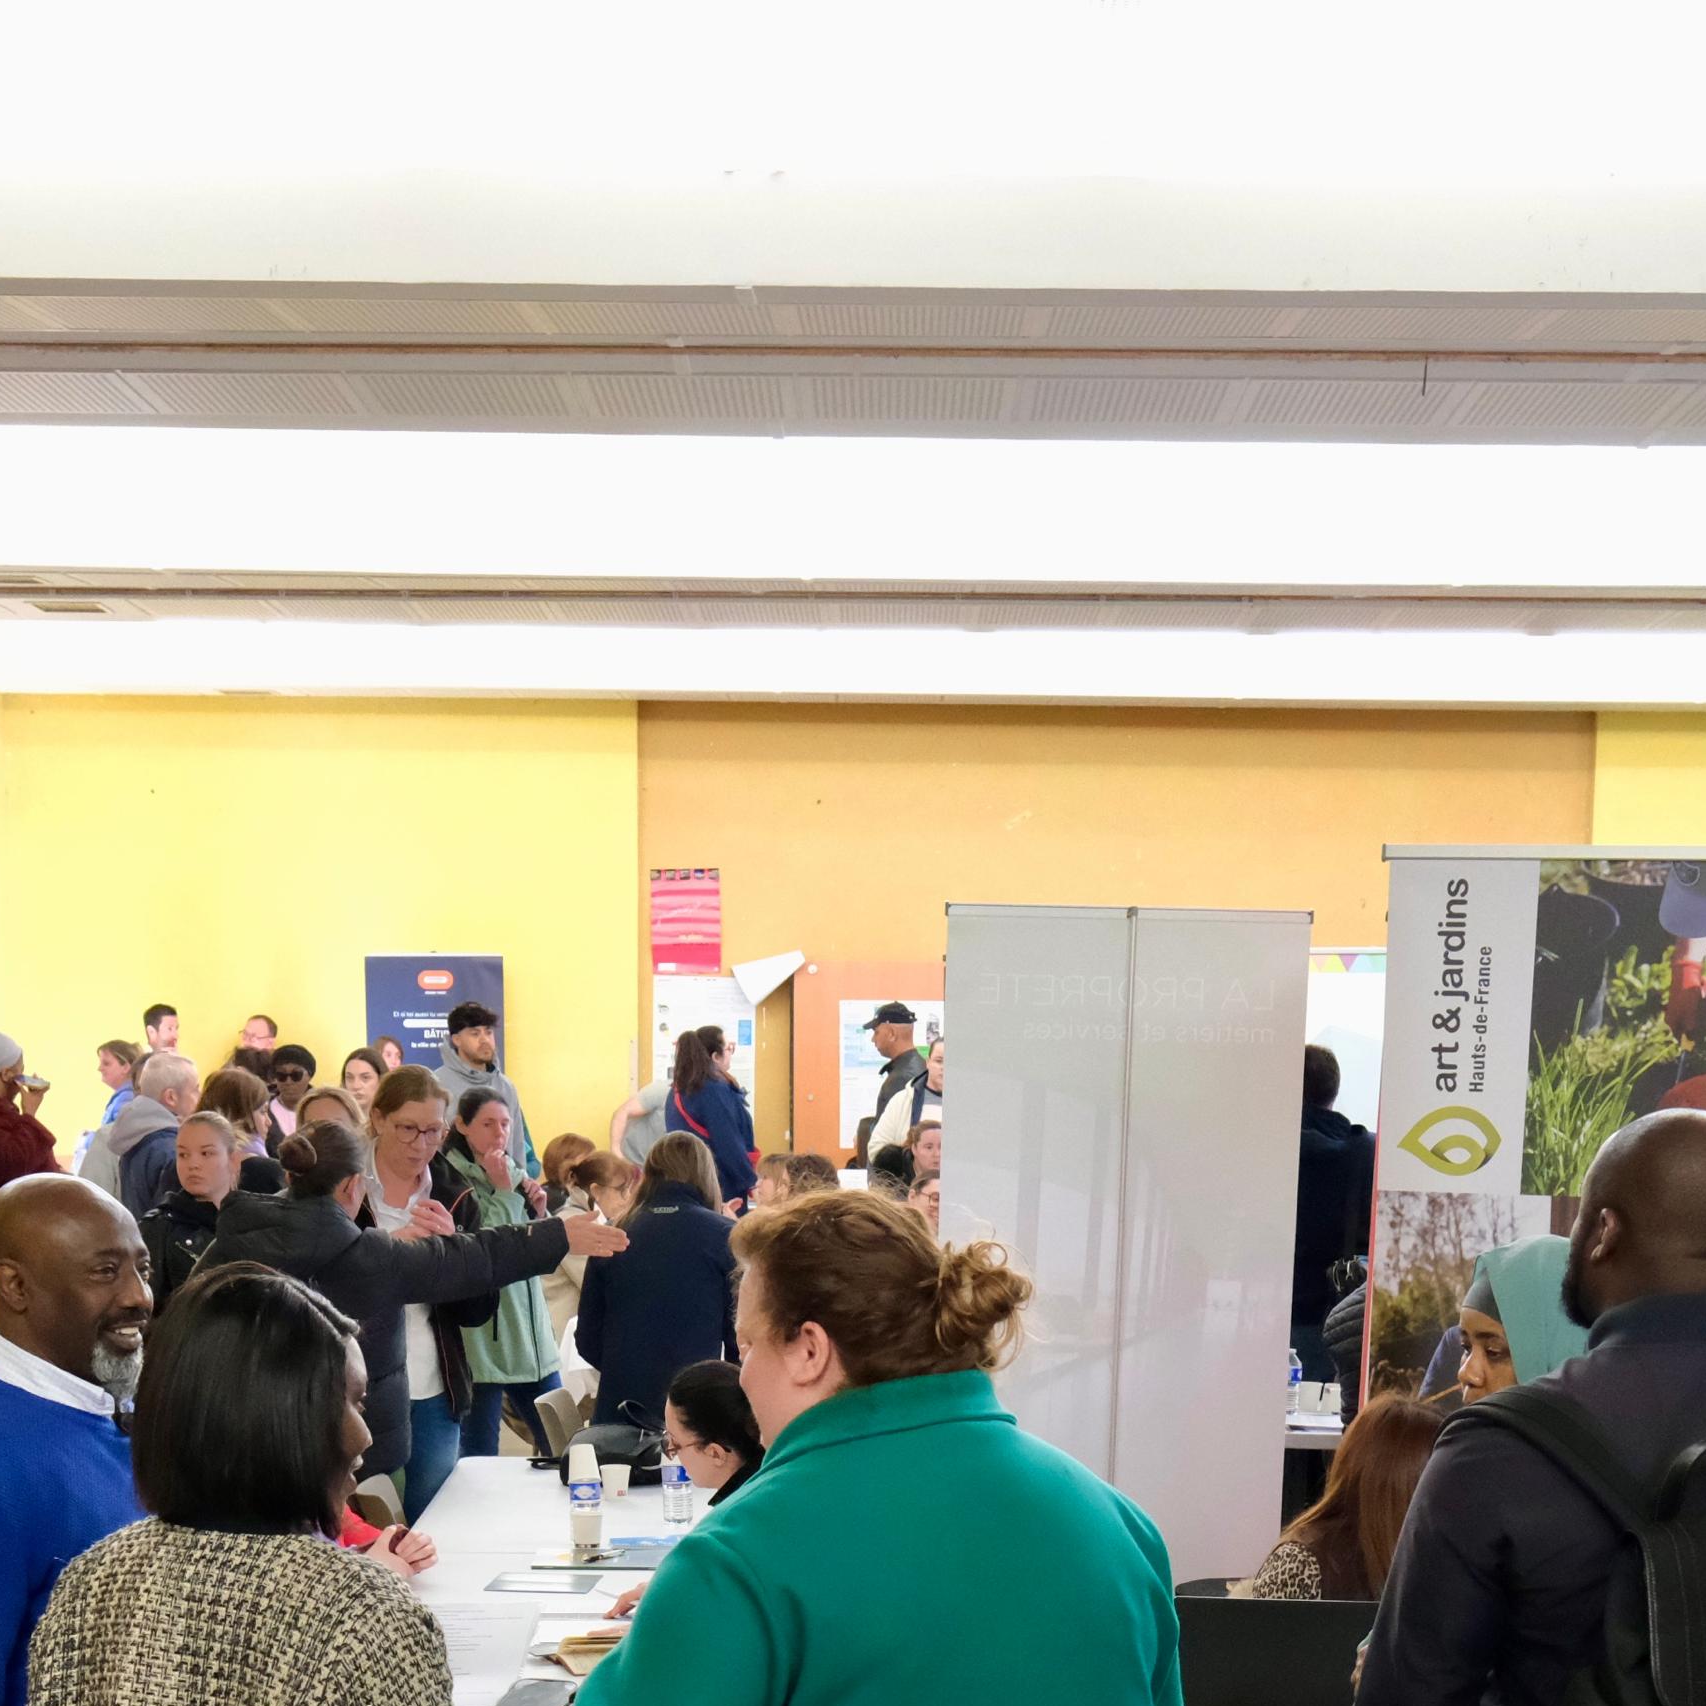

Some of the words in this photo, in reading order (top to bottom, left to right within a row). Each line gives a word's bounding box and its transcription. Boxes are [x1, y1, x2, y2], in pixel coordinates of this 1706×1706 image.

[1434, 878, 1470, 1002] jardins
[1432, 1006, 1461, 1034] &
[1468, 946, 1493, 1093] Hauts-de-France
[1431, 1041, 1459, 1093] art
